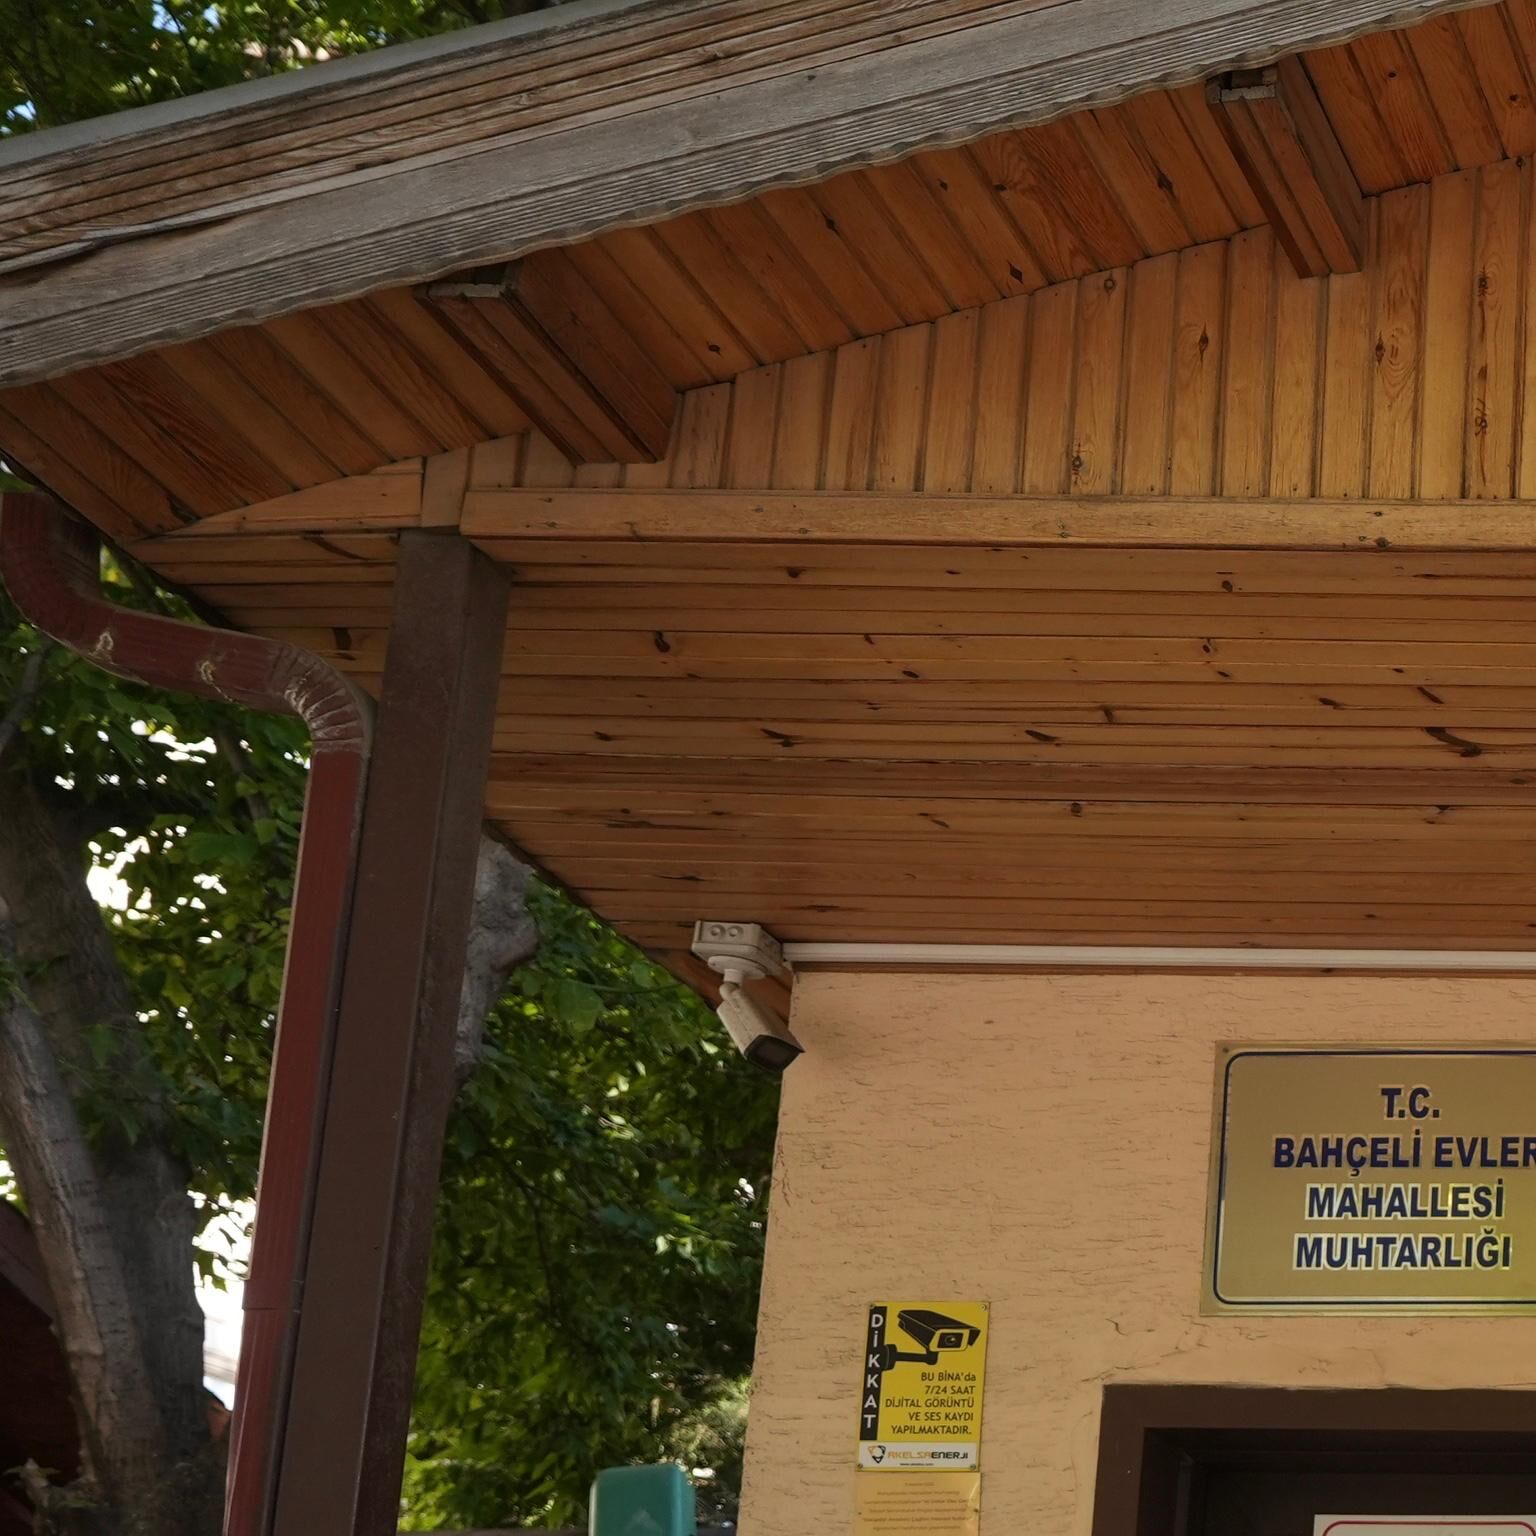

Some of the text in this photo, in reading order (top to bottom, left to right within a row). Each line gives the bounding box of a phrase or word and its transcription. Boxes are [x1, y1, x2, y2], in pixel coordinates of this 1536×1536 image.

[1380, 1086, 1441, 1120] T.C.
[1273, 1128, 1421, 1177] BAHÇELİ
[1306, 1177, 1504, 1219] MAHALLESİ
[1294, 1227, 1512, 1270] MUHTARLIĞI
[921, 1371, 935, 1382] BU
[925, 1385, 976, 1395] 7/24 SAAT
[909, 1412, 974, 1422] VE SES KAYDI
